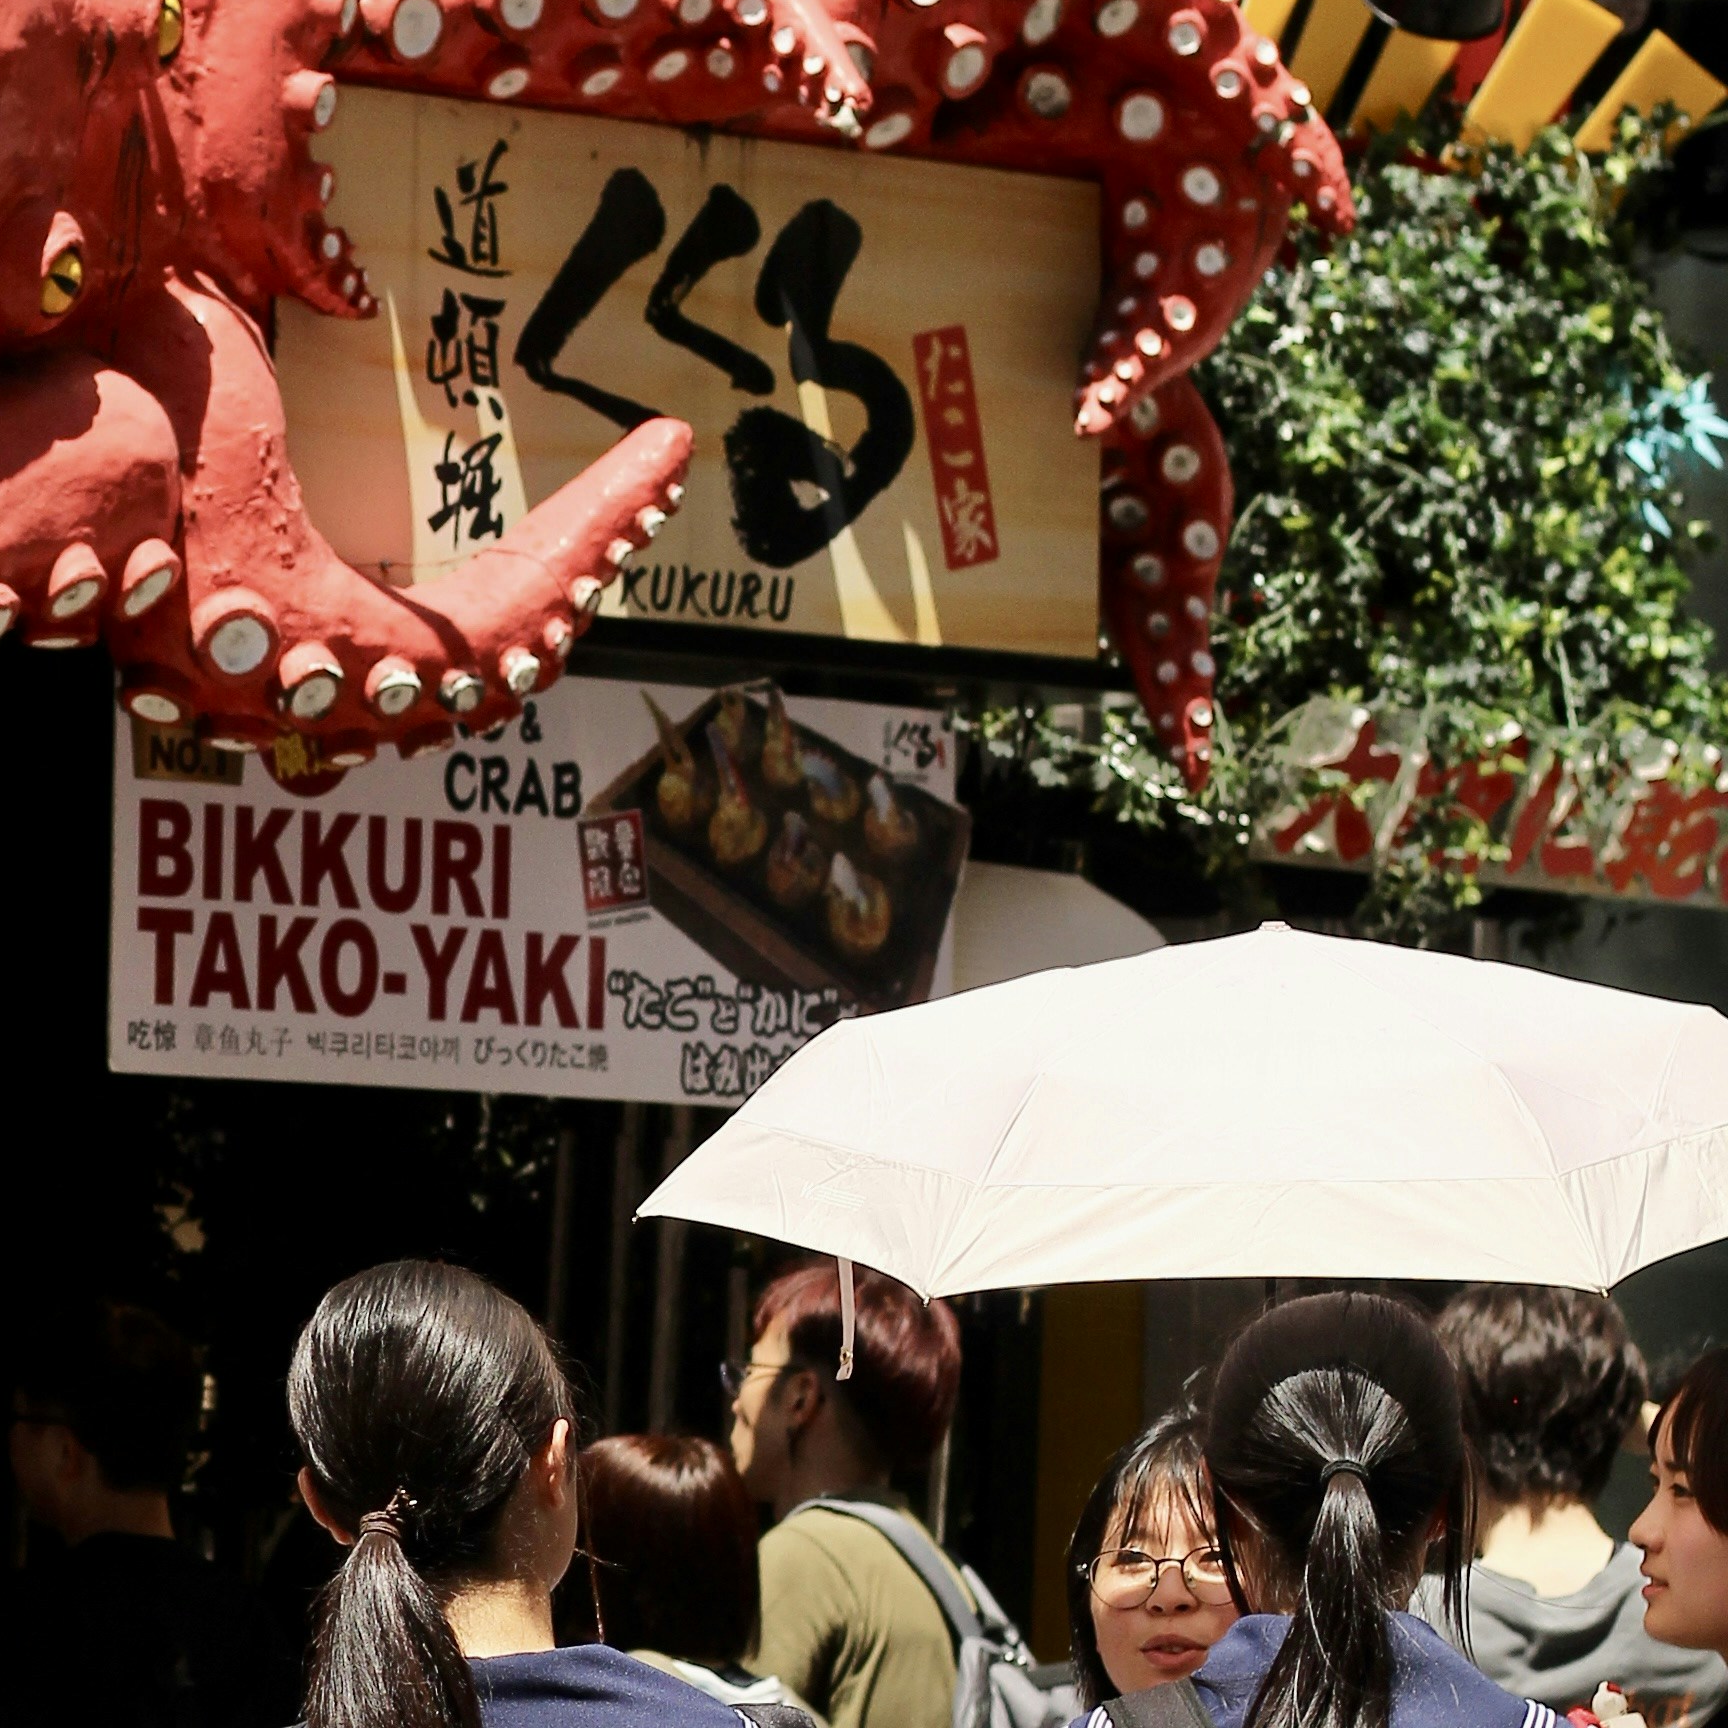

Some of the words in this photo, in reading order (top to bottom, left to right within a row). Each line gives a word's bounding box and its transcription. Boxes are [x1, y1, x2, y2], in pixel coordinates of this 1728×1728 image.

[425, 139, 515, 549] 道頓堀
[514, 167, 915, 569] くくる
[620, 564, 796, 623] KUKURU
[444, 750, 582, 819] CRAB
[137, 798, 513, 921] BIKKURI
[136, 908, 608, 1031] TAKO-YAKI
